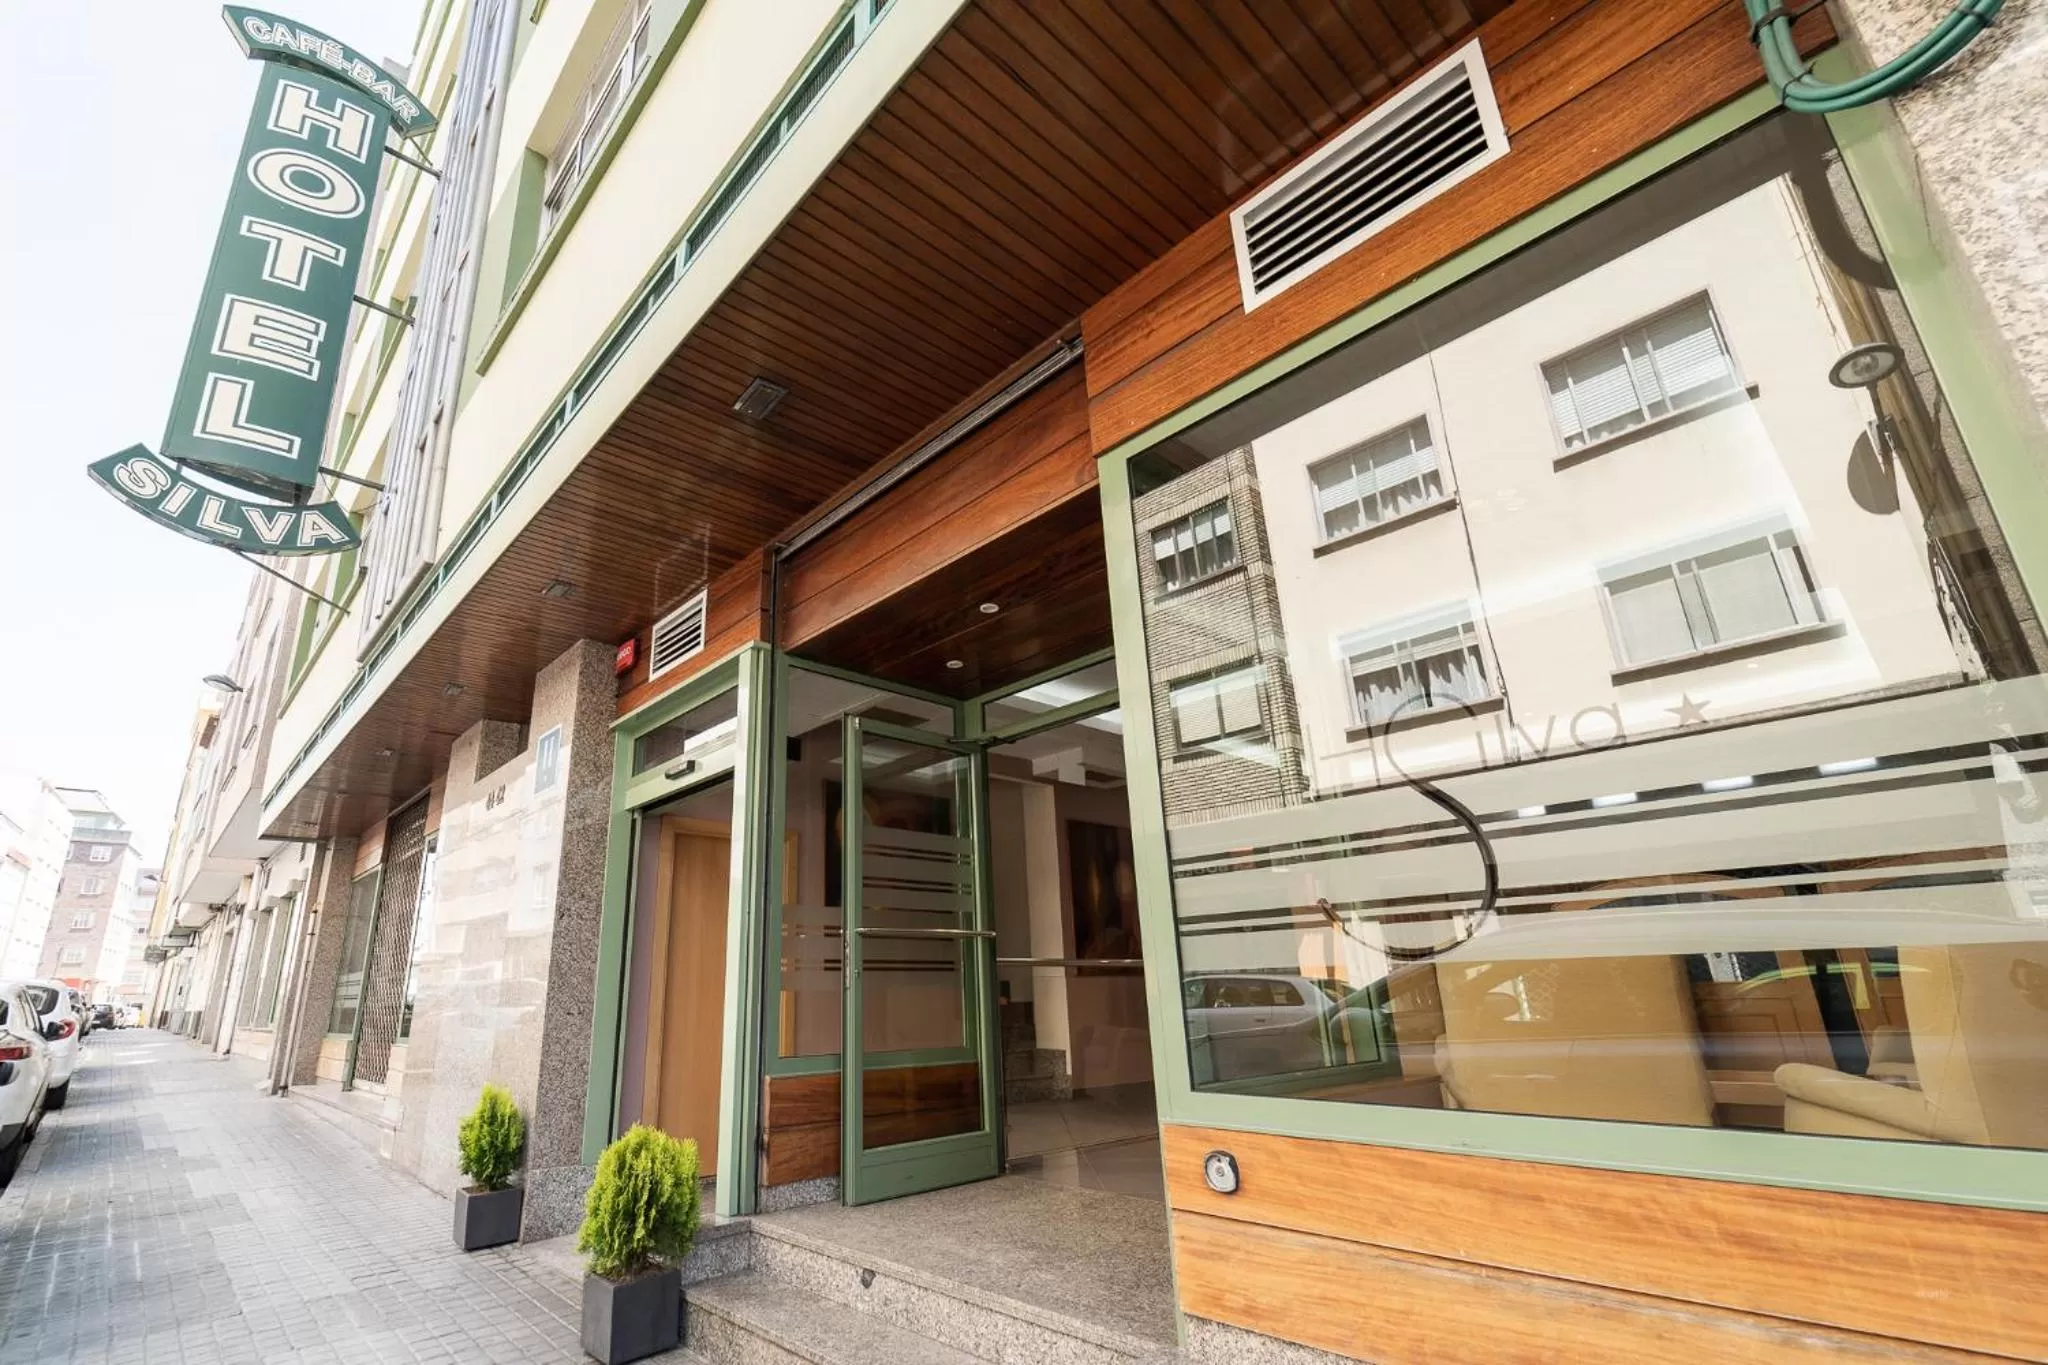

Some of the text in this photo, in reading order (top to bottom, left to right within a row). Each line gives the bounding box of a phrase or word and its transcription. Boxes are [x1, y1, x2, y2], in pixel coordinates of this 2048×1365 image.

[243, 15, 421, 125] CAFÉ-BAR
[193, 78, 376, 460] HOTEL
[113, 456, 350, 547] SILVA
[1316, 691, 1628, 962] Silva
